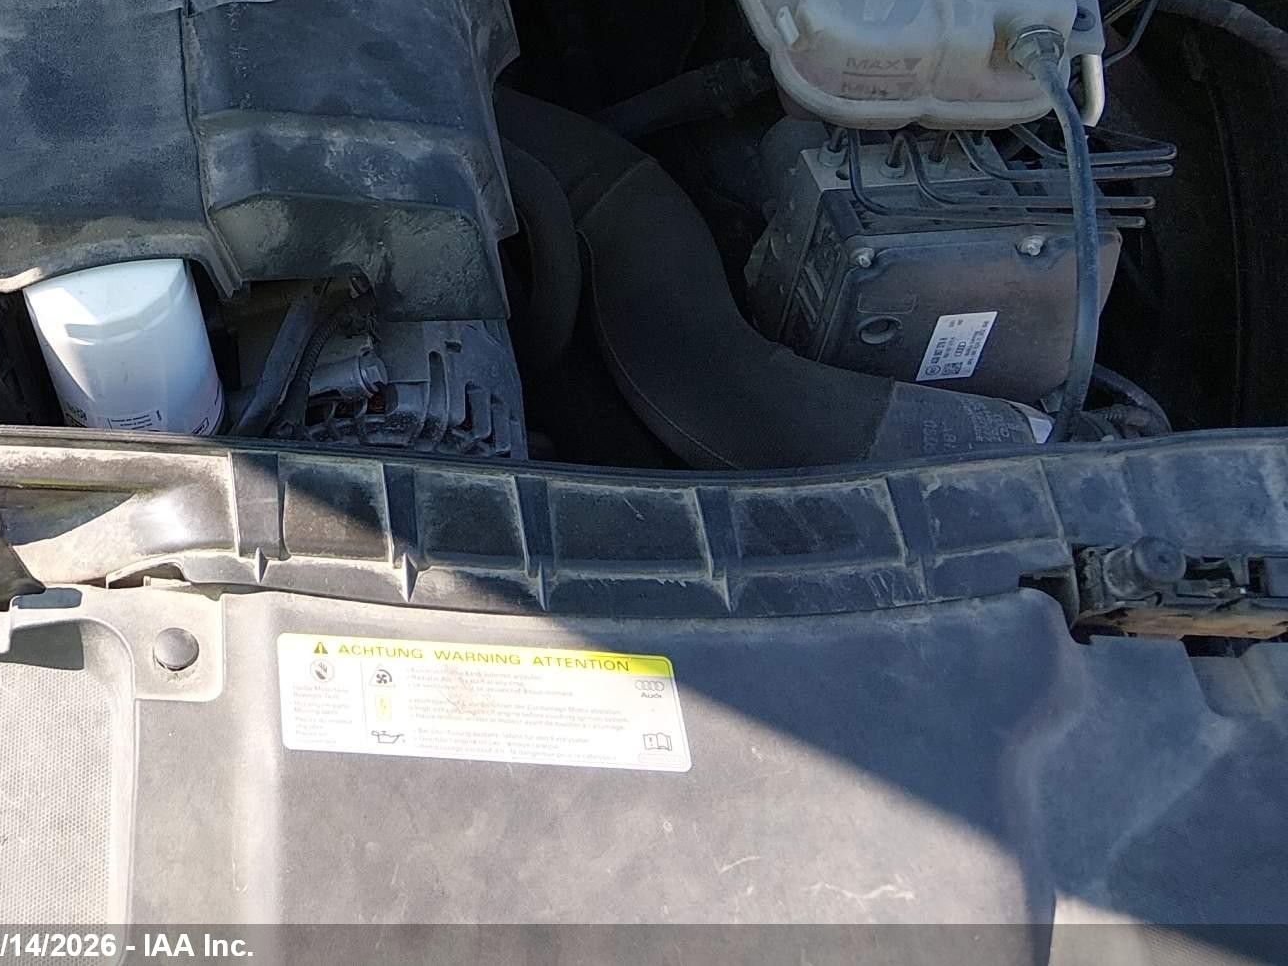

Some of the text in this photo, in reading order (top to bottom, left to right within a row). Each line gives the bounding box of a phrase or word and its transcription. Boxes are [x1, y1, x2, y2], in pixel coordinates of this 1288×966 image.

[338, 643, 630, 672] ACHTUNG WARNING ATTENTION
